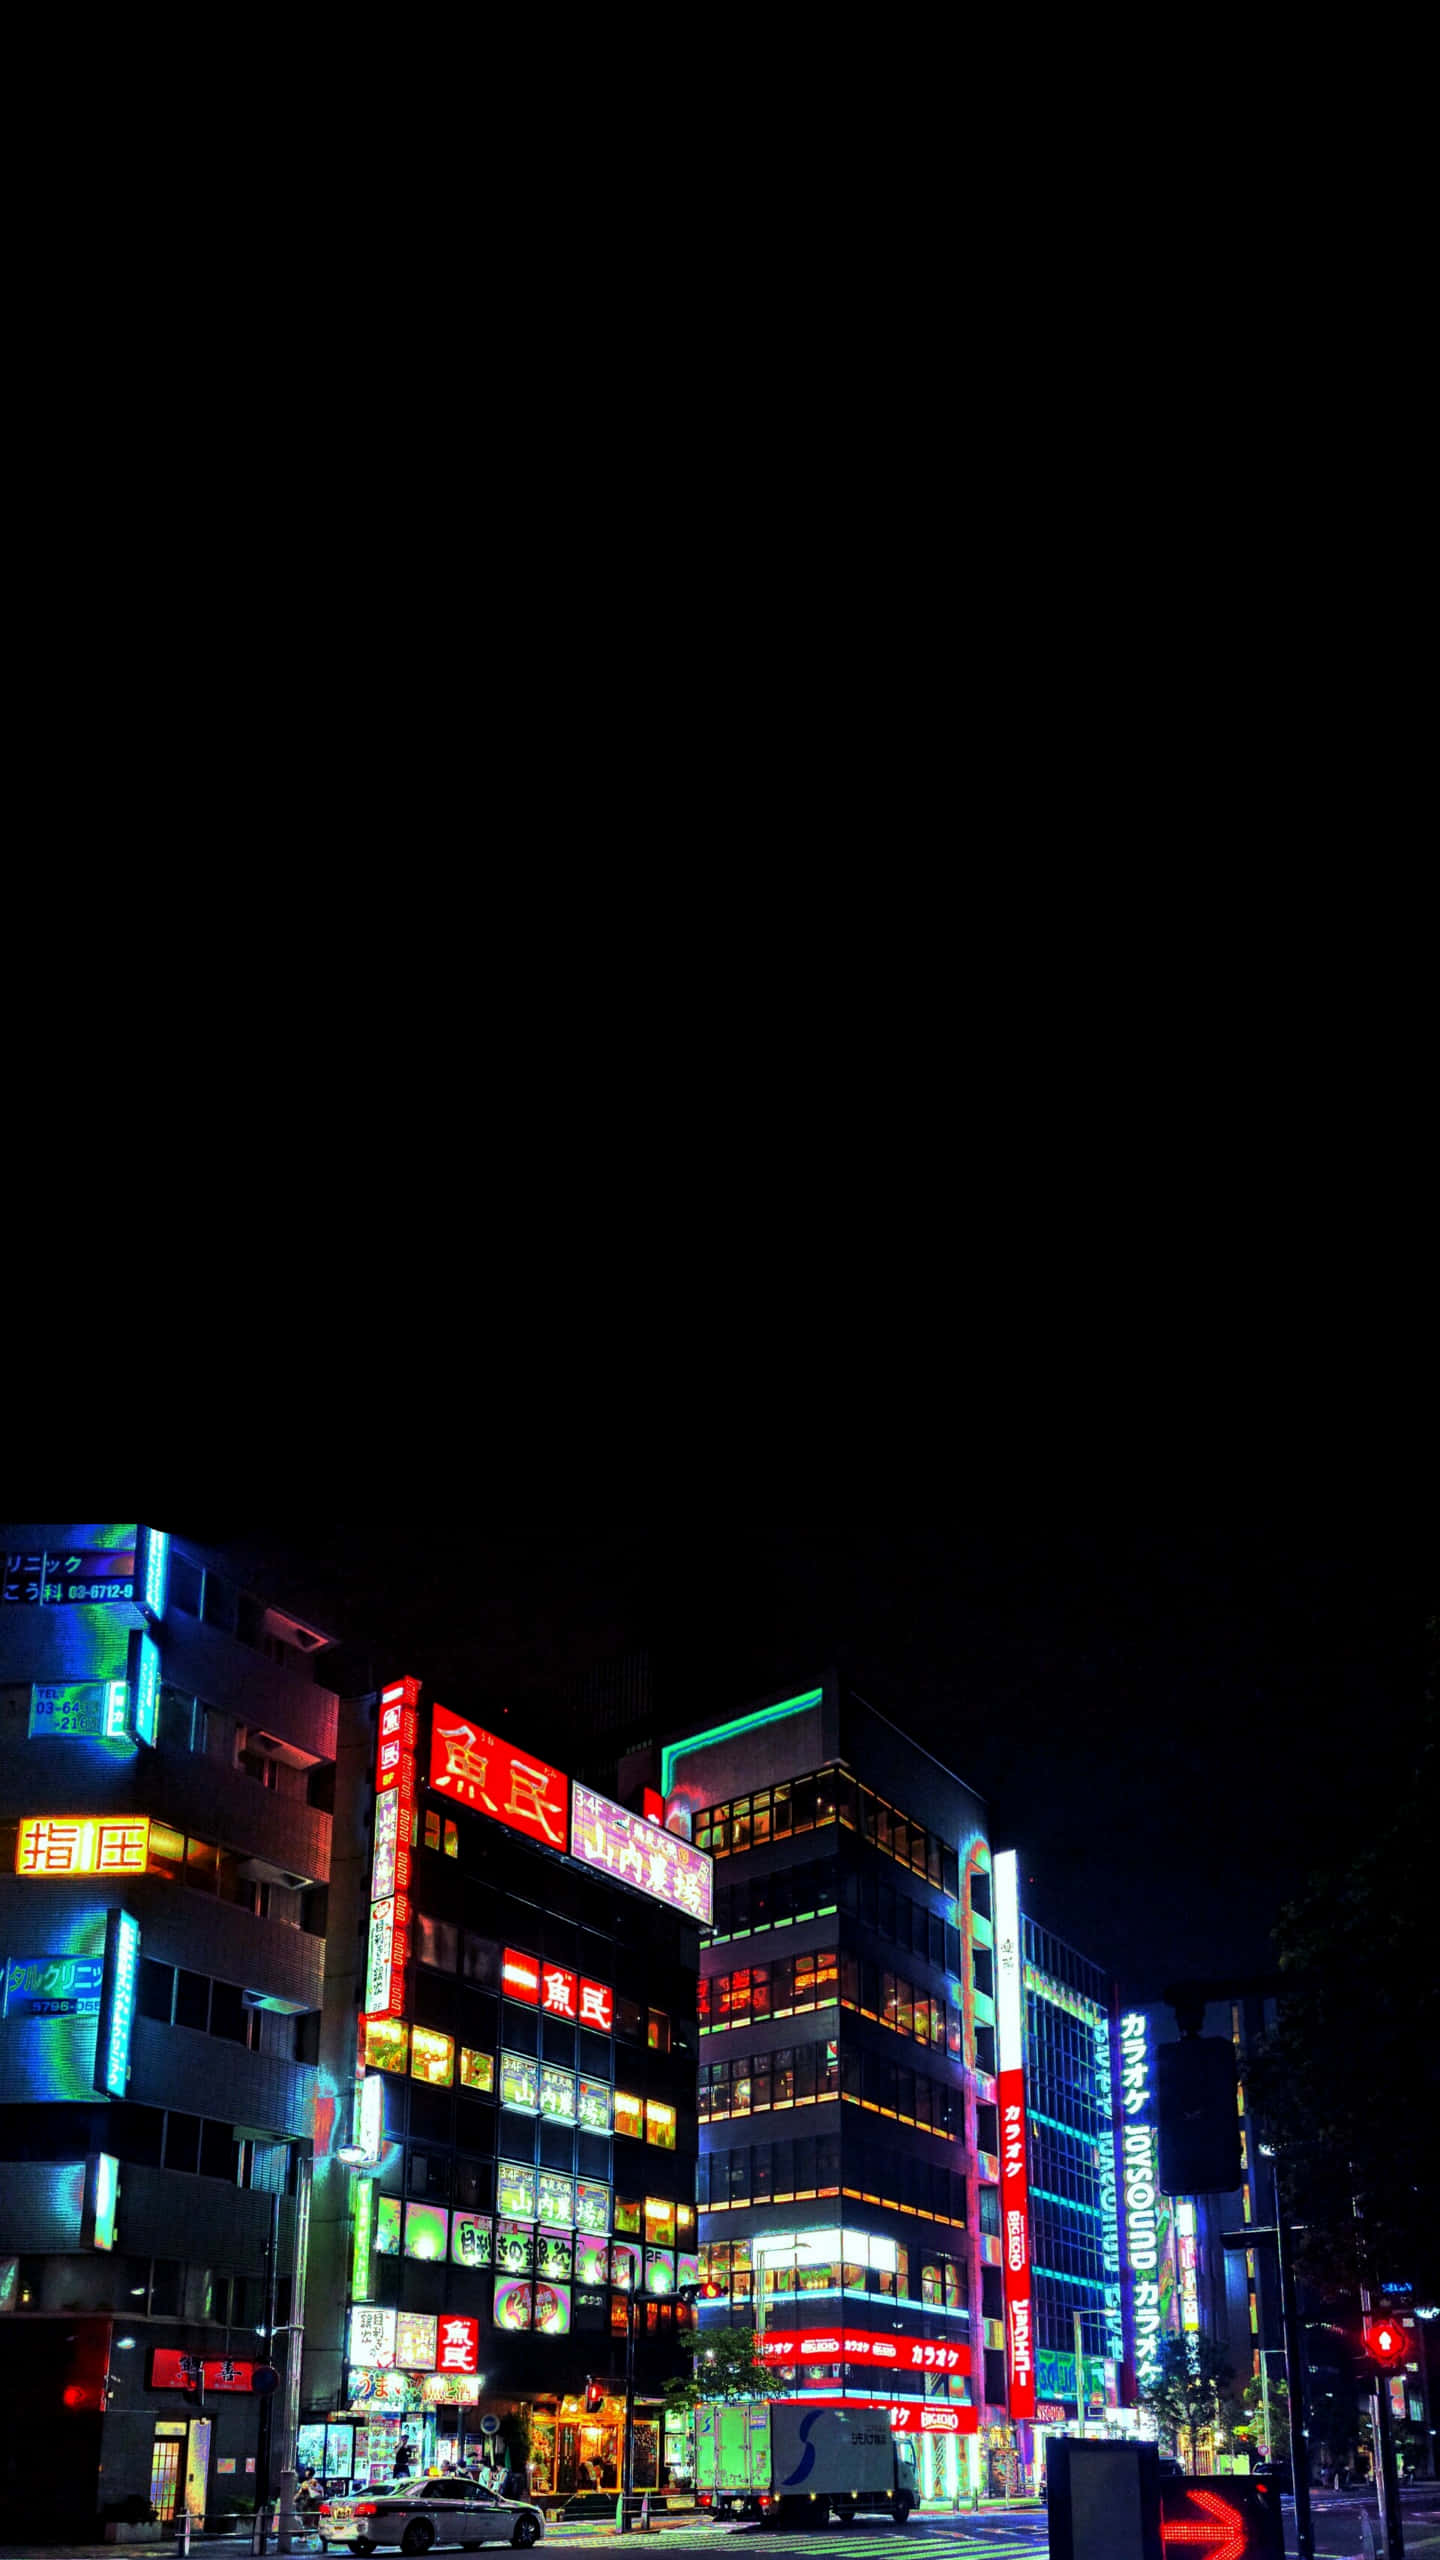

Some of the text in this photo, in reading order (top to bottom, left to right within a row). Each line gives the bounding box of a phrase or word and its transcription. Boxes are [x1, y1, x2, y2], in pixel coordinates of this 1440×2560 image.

[436, 1726, 562, 1844] 魚民
[25, 1823, 145, 1870] 指圧
[543, 1973, 611, 2029] 魚民
[1121, 2012, 1150, 2115] カラオケ
[1004, 2105, 1023, 2178] カラオケ
[1124, 2125, 1157, 2270] JOYSOUND
[646, 2250, 662, 2264] 2F
[442, 2320, 475, 2371] 魚民
[912, 2345, 959, 2368] カラオケ
[1134, 2280, 1164, 2388] カラオケ
